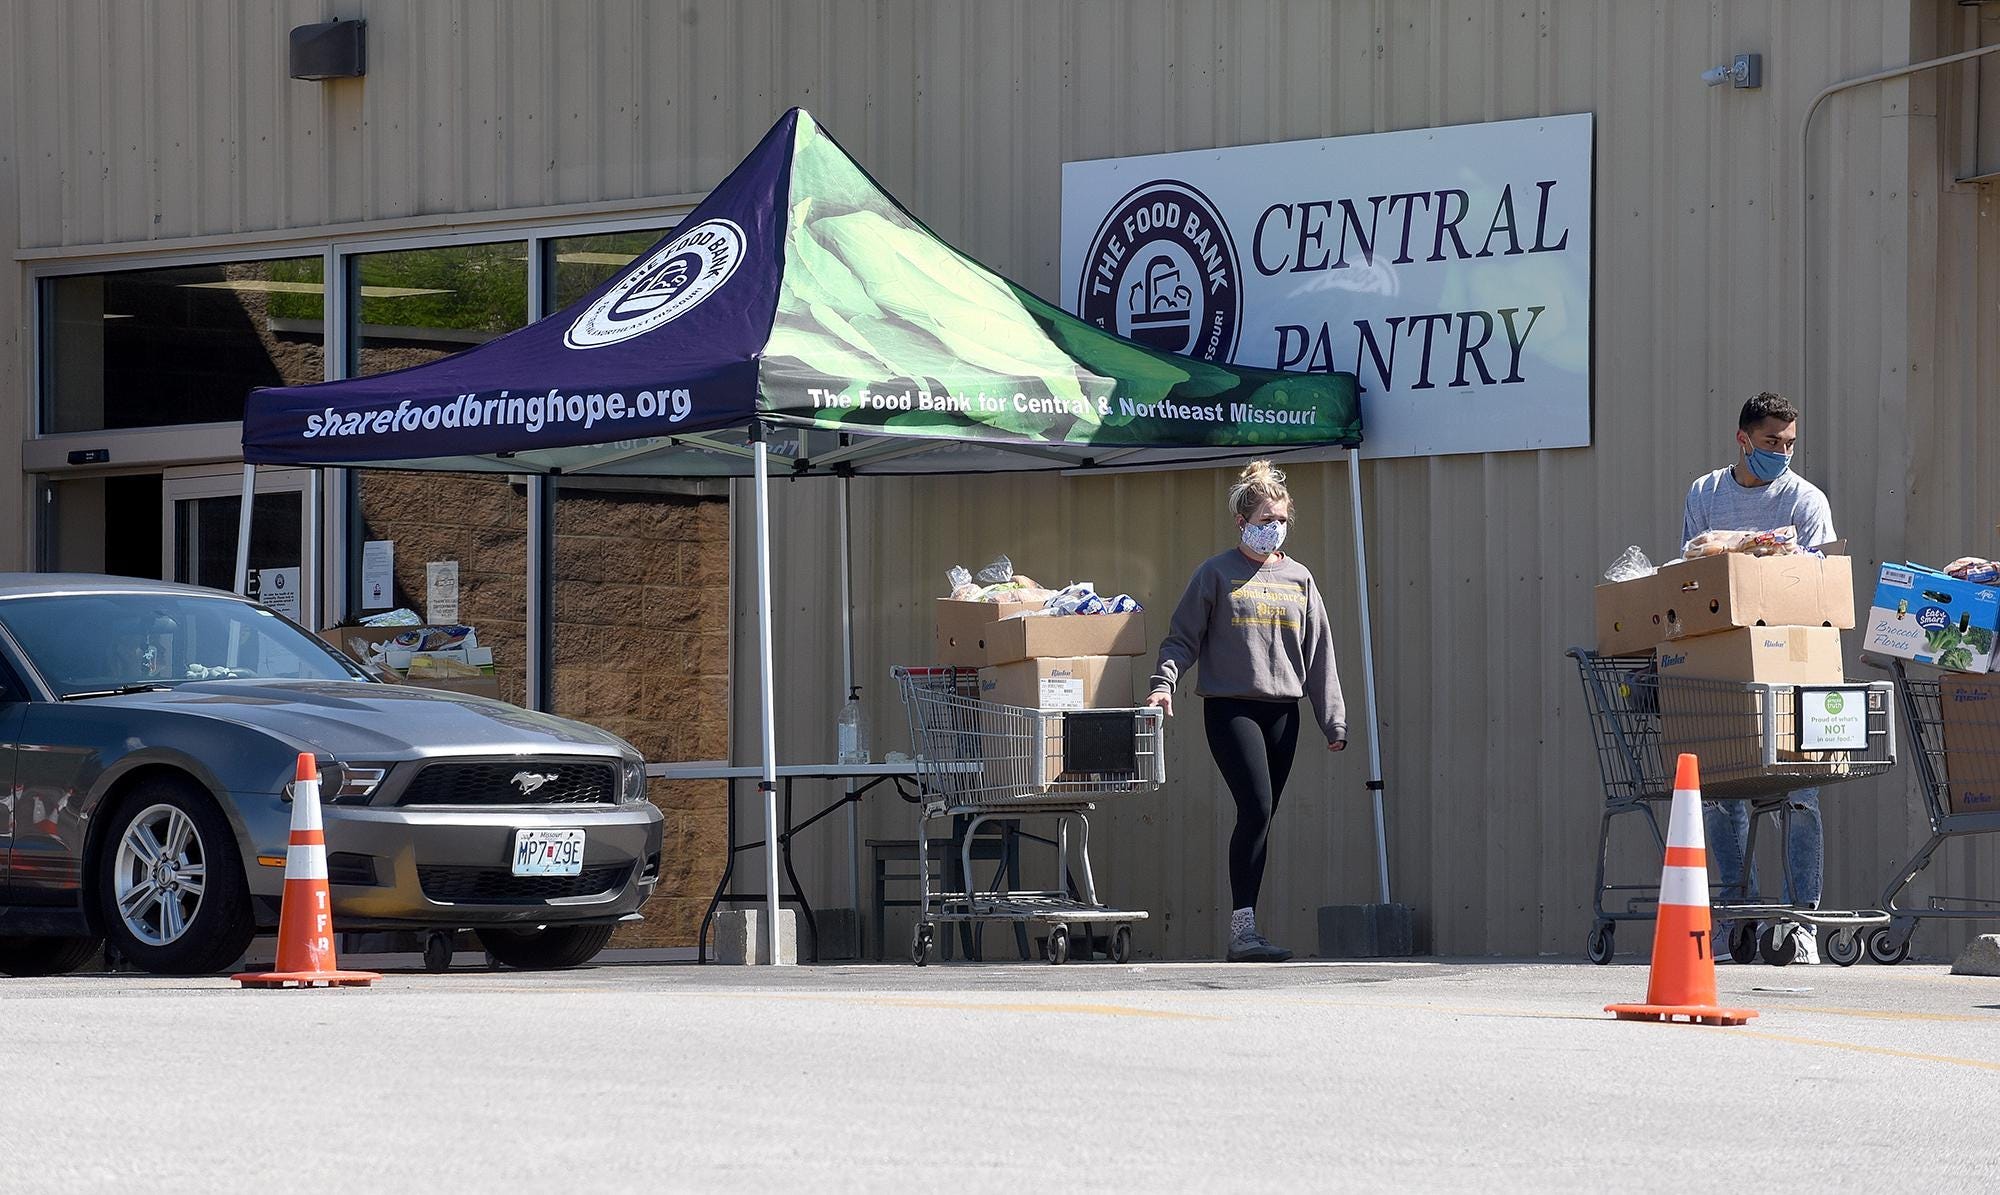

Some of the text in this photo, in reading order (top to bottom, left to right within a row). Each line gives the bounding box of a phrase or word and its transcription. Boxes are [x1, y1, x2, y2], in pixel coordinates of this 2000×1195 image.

[1252, 180, 1569, 277] CENTRAL
[1092, 202, 1228, 296] THE FOOD BANK
[615, 232, 729, 292] THE FOOD BANK
[653, 287, 703, 321] MISSOURI
[1274, 306, 1546, 393] PANTRY
[302, 388, 692, 438] sharefoodbringhope.org
[808, 388, 1317, 425] The Food Bank for Central & Northeast Missouri
[1231, 588, 1306, 605] Shakespeare's
[1257, 602, 1287, 616] Pizza
[1920, 615, 1944, 627] Smart
[1925, 608, 1940, 618] Eat
[1875, 620, 1919, 639] Broccoli
[1874, 633, 1910, 651] Florets
[1825, 724, 1845, 734] NOT
[517, 841, 547, 865] MP7
